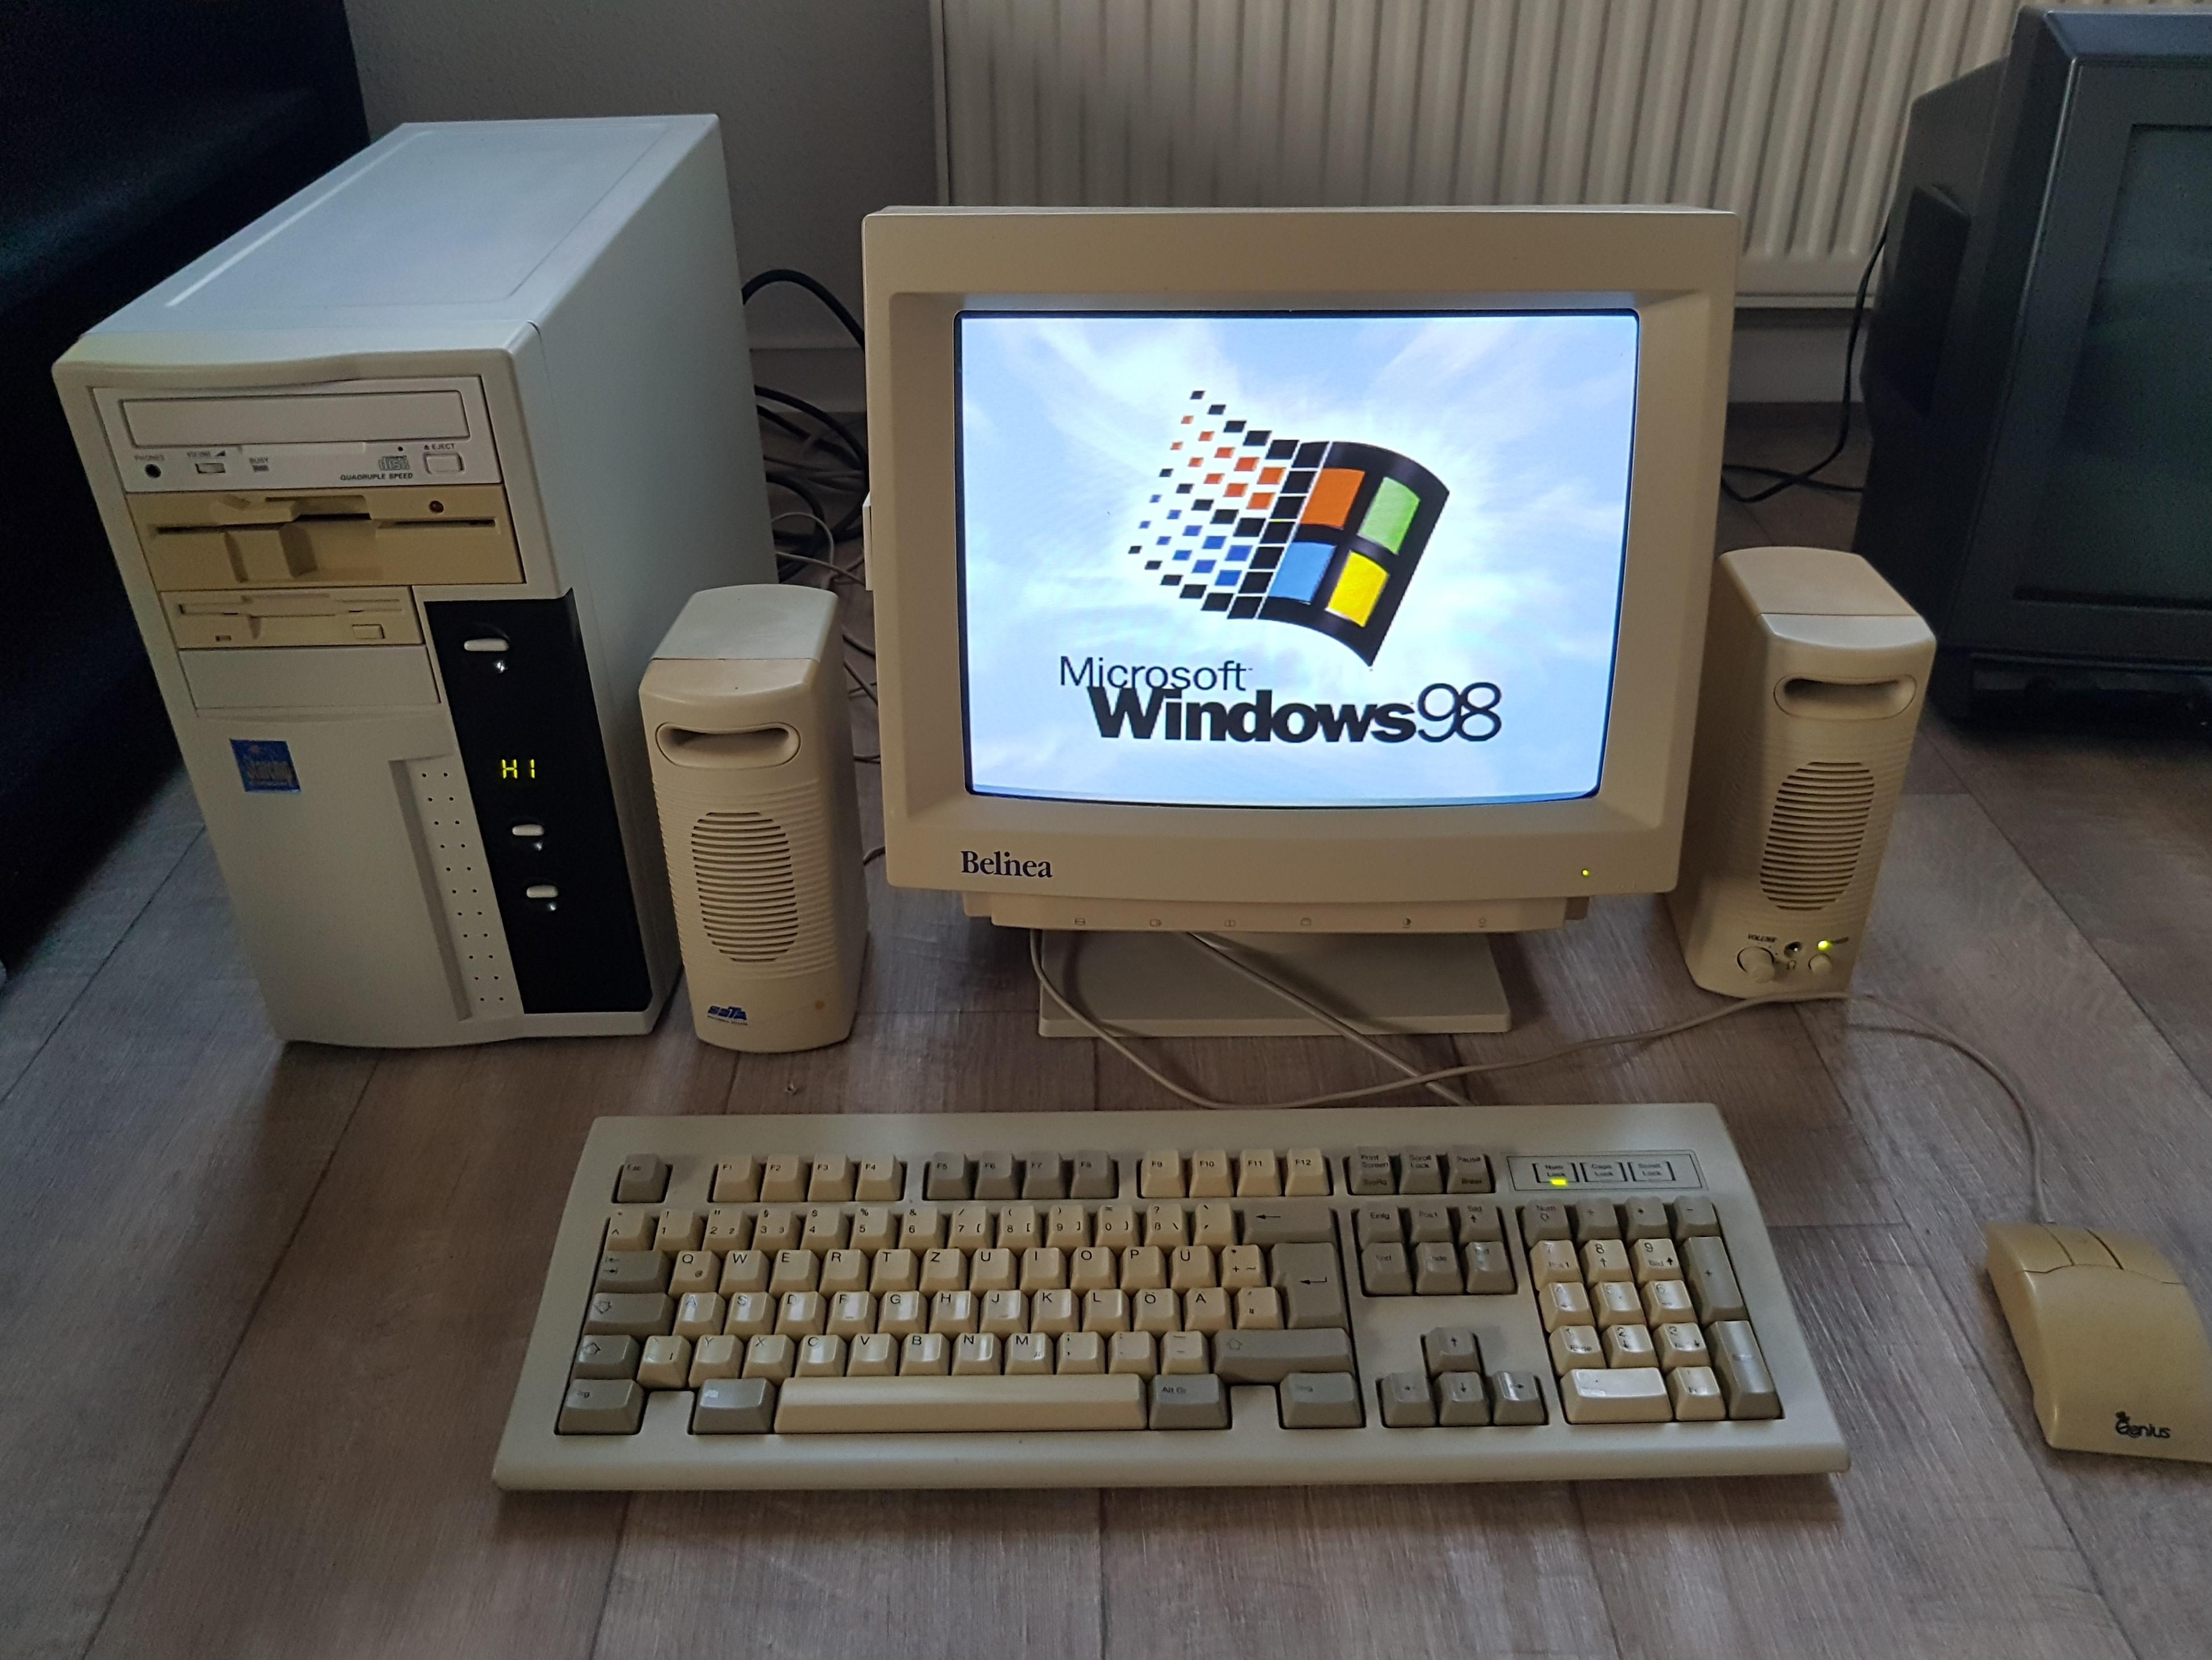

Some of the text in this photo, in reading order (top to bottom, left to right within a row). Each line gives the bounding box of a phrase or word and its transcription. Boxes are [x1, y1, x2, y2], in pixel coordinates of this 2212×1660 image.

[1060, 656, 1248, 691] Microsoft
[1088, 685, 1417, 743] Windows
[961, 850, 1052, 878] Belinea
[661, 1226, 666, 1235] 1
[709, 1226, 718, 1235] 2
[760, 1225, 768, 1234] 3
[809, 1225, 817, 1234] 4
[859, 1225, 867, 1233] 5
[909, 1225, 916, 1234] 6
[957, 1224, 965, 1233] 7
[1006, 1224, 1014, 1233] 8
[1595, 1243, 1605, 1254] 8
[1644, 1242, 1654, 1253] 9
[682, 1253, 694, 1264] Q
[732, 1253, 748, 1264] W
[781, 1252, 790, 1263] E
[831, 1252, 842, 1262] R
[882, 1251, 892, 1262] T
[930, 1252, 941, 1262] Z
[980, 1251, 992, 1262] U
[1034, 1250, 1038, 1261] I
[1080, 1250, 1093, 1260] O
[1130, 1249, 1140, 1259] P
[685, 1296, 696, 1307] A
[737, 1295, 747, 1306] S
[839, 1293, 848, 1304] F
[890, 1293, 901, 1304] G
[940, 1293, 951, 1304] H
[992, 1293, 999, 1304] J
[1042, 1292, 1052, 1303] K
[1093, 1292, 1102, 1303] L
[705, 1337, 714, 1346] Y
[755, 1337, 765, 1346] X
[807, 1337, 819, 1347] C
[860, 1336, 870, 1346] V
[911, 1336, 922, 1345] B
[963, 1334, 975, 1345] N
[1015, 1334, 1029, 1345] M
